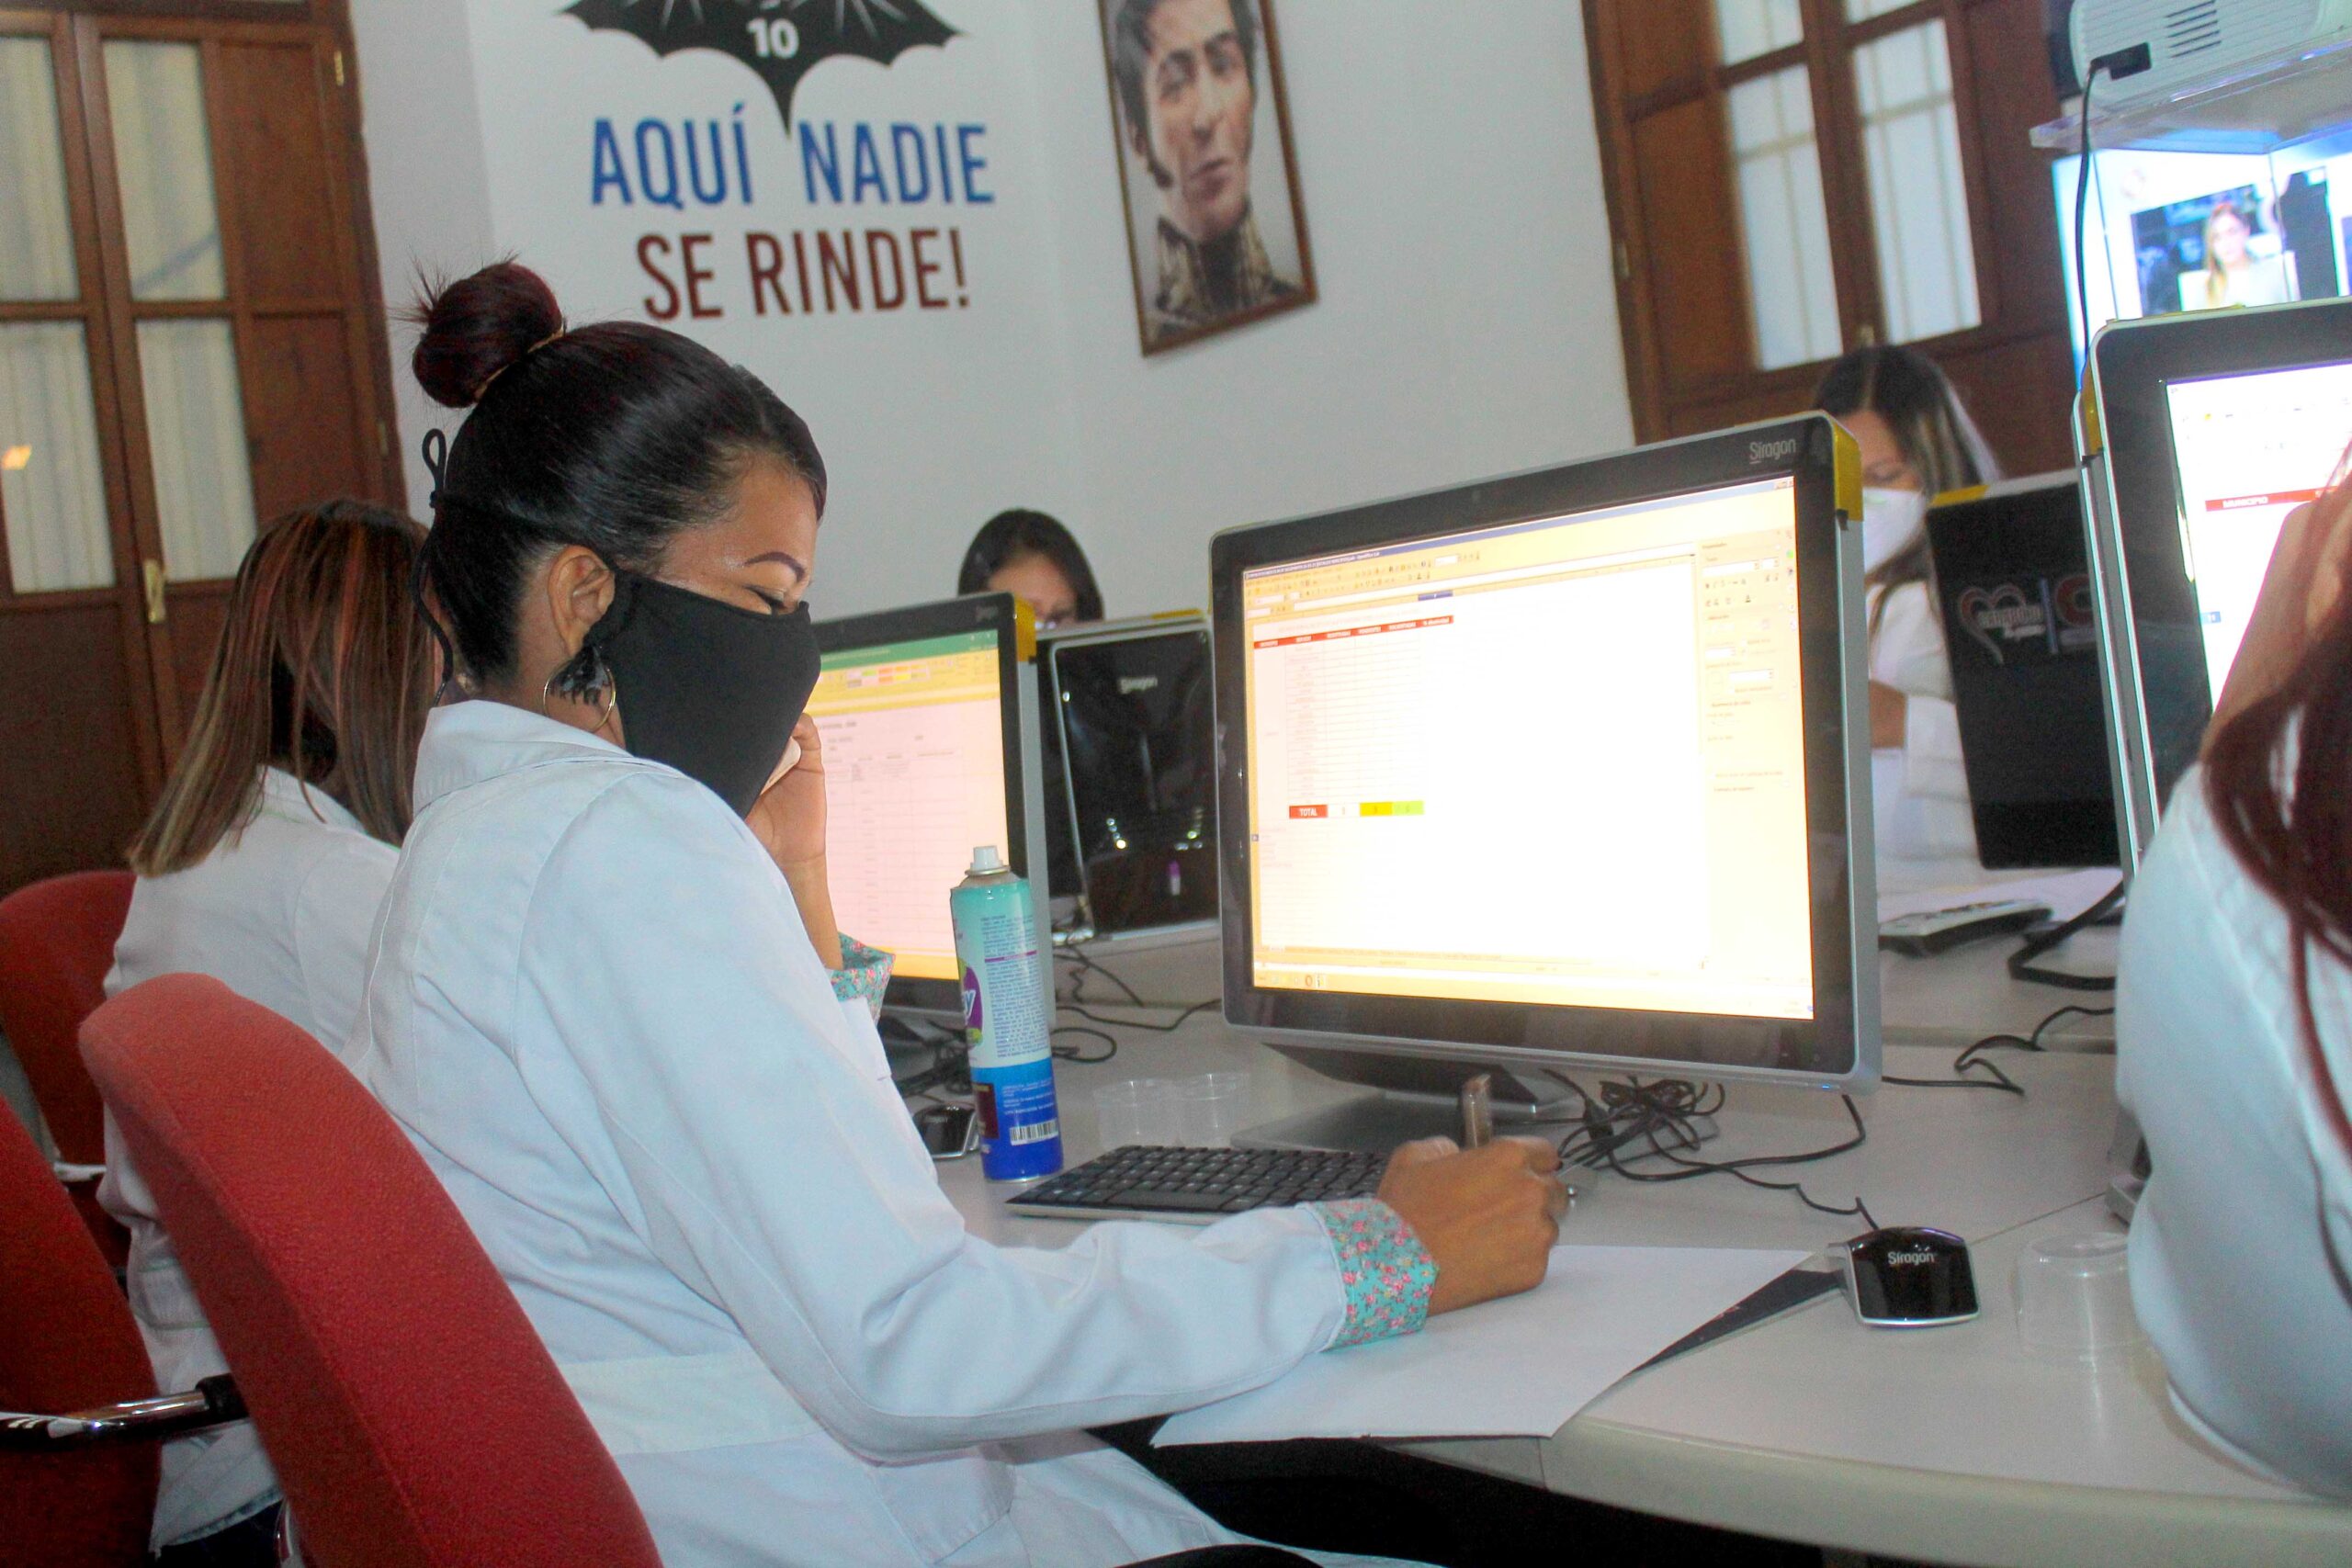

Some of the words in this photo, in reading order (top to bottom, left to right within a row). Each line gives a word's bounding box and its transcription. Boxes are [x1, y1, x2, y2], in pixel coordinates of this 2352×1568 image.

[747, 17, 798, 58] 10
[591, 100, 753, 210] AQUÍ
[797, 121, 995, 204] NADIE
[636, 231, 724, 321] SE
[745, 228, 969, 315] RINDE!
[1299, 807, 1317, 818] TOTAL
